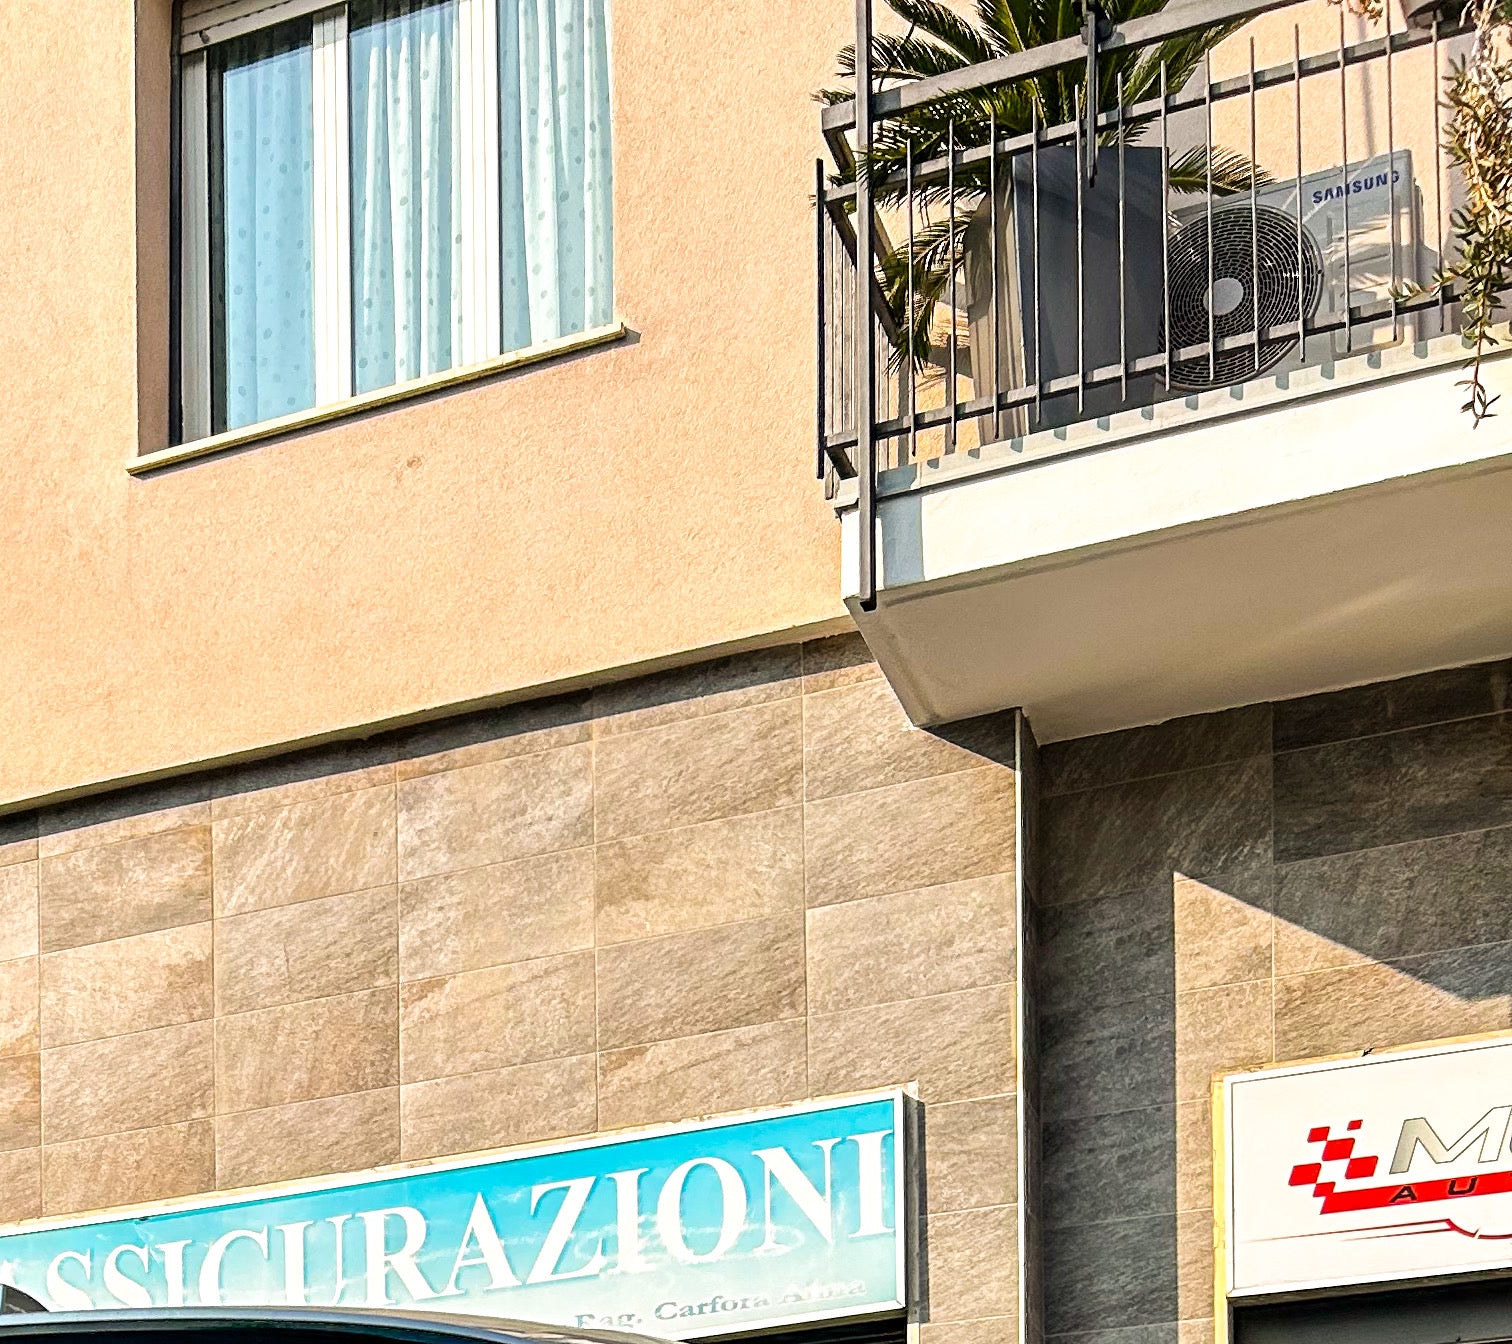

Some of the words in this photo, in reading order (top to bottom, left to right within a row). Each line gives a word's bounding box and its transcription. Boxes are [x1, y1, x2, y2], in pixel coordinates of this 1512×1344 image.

[1312, 170, 1400, 204] SAMSUNG
[1389, 1105, 1512, 1174] M
[1388, 1172, 1512, 1203] AU
[654, 1295, 769, 1321] Carfora
